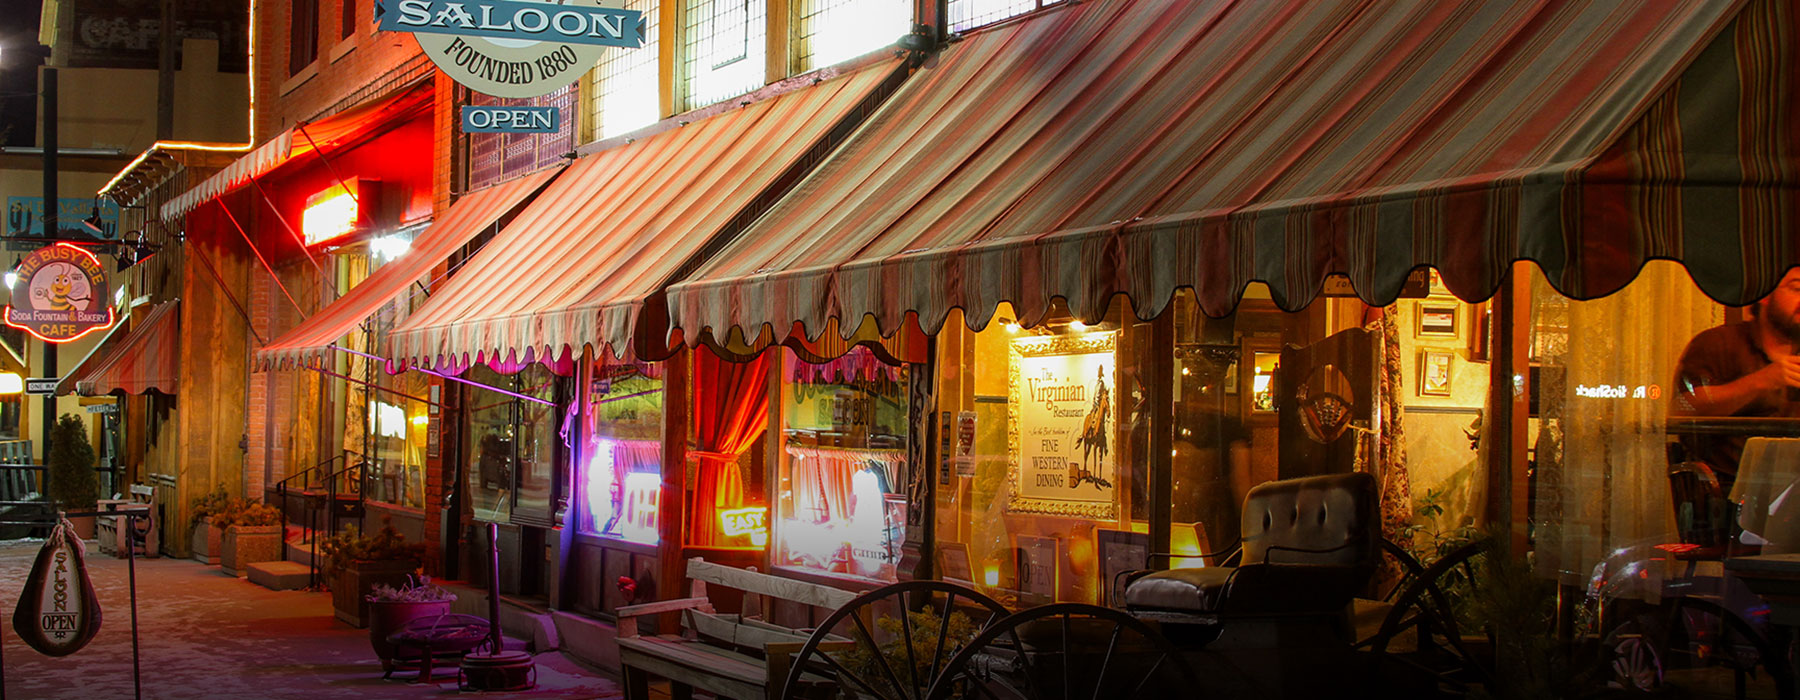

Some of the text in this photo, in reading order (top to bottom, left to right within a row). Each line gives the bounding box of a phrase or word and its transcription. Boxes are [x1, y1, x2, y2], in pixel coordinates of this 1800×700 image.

[397, 1, 626, 39] SALOON
[444, 36, 578, 85] FOUNDED 1880
[469, 109, 553, 129] OPEN
[17, 247, 104, 286] THE BUSY BEE
[69, 310, 77, 322] &
[39, 324, 77, 336] CAFE
[1041, 367, 1053, 381] The
[29, 382, 43, 390] ONE
[1027, 377, 1085, 411] Virginian
[1053, 405, 1085, 418] Restaurant
[1041, 439, 1059, 453] FINE
[1032, 456, 1068, 470] WESTERN
[1036, 474, 1064, 488] DINING
[53, 551, 68, 612] SALOON
[42, 614, 77, 630] OPEN
